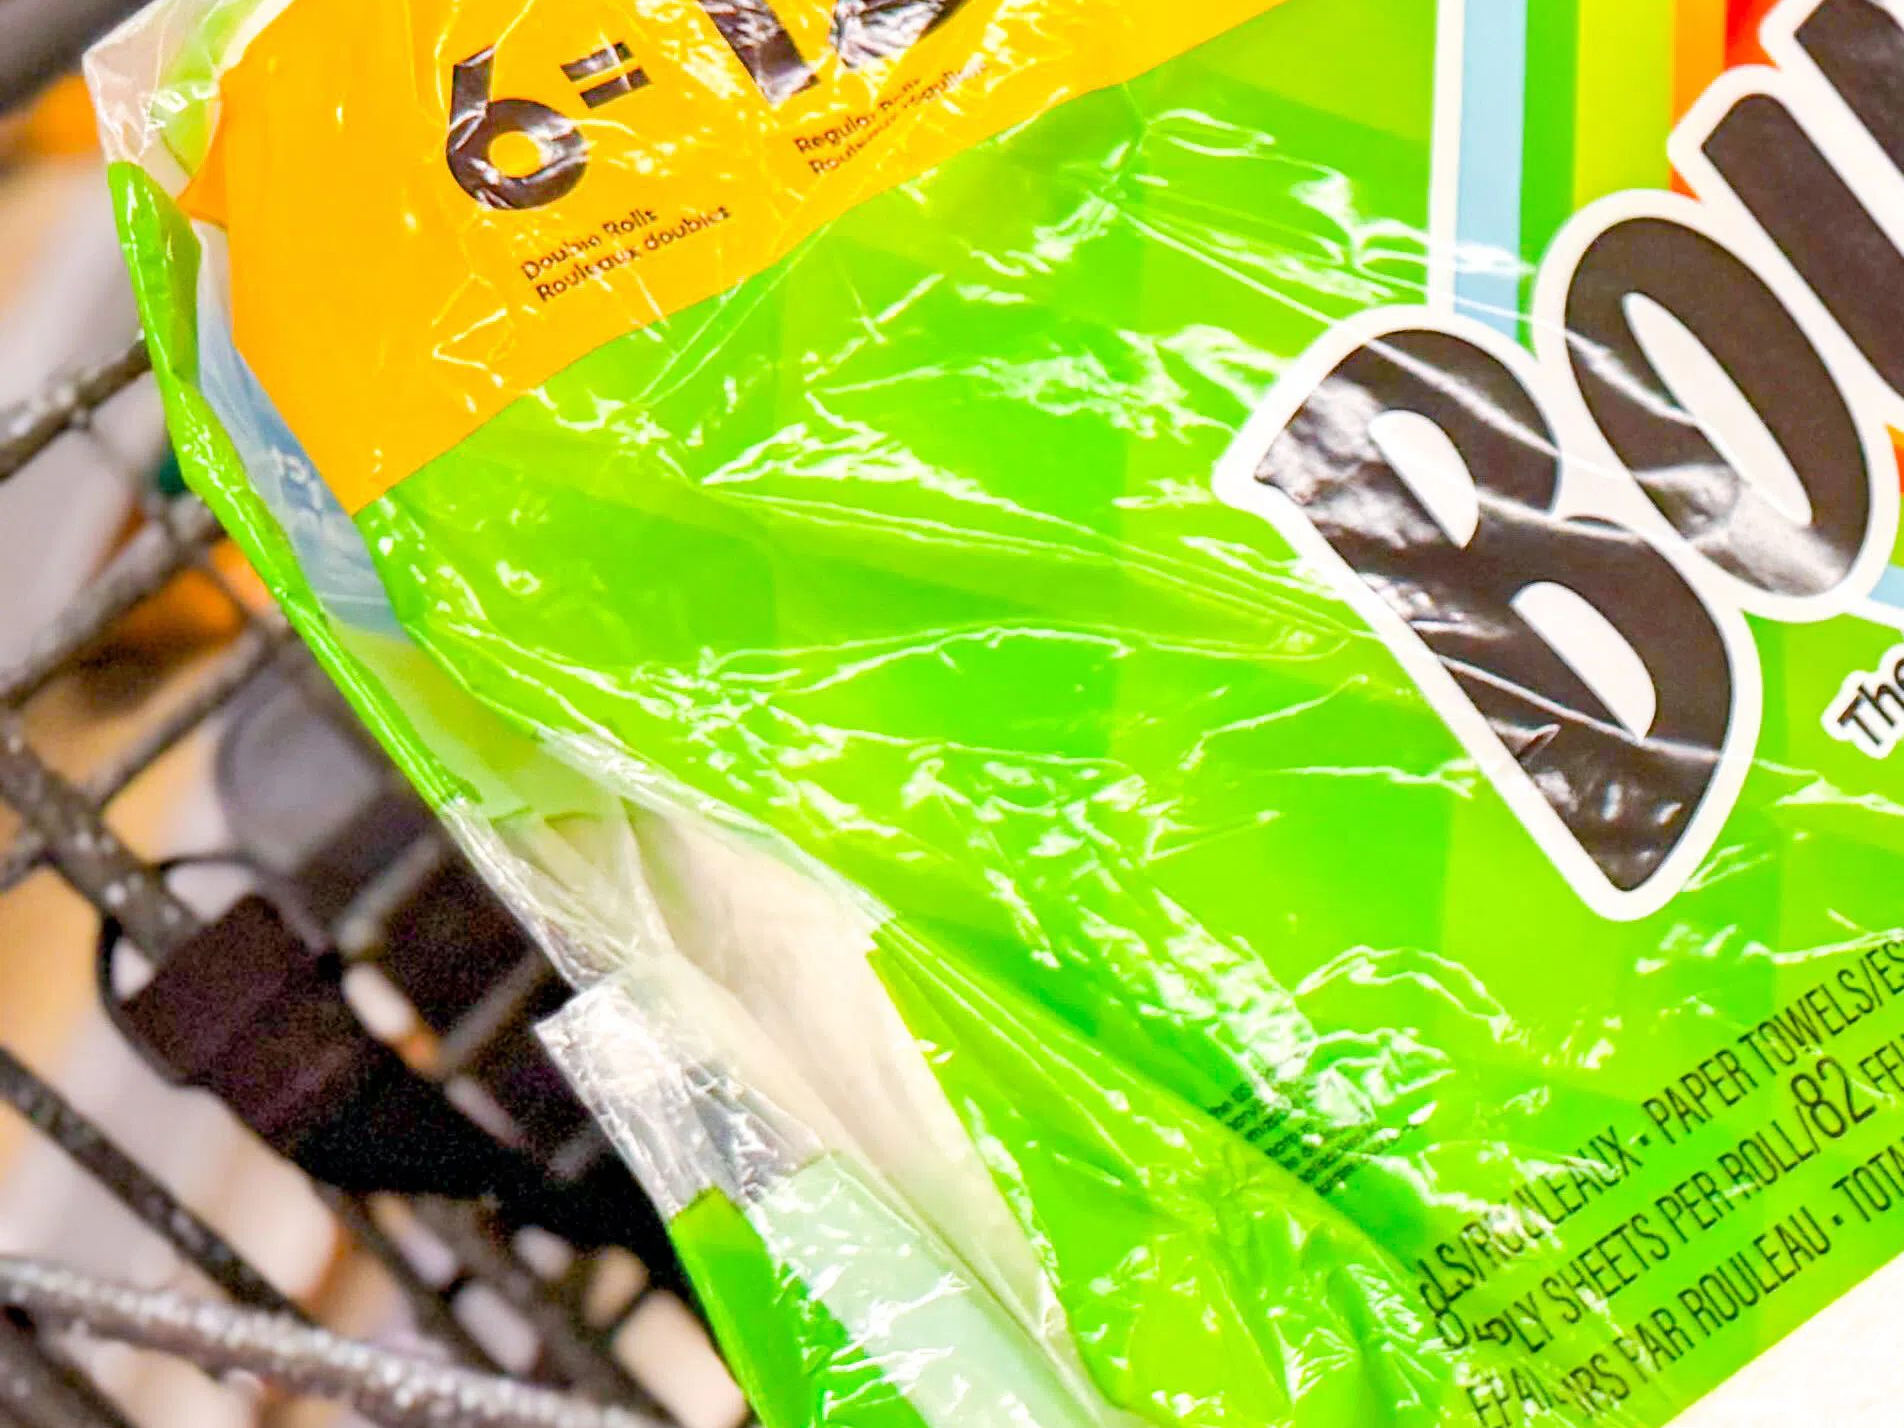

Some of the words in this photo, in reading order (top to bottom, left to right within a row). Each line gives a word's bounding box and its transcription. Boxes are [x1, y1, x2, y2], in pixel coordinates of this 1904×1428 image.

[1643, 1048, 1755, 1146] PAPER
[1540, 1211, 1673, 1325] SHEETS
[1655, 1168, 1736, 1250] PER
[1680, 1204, 1832, 1327] ROULEAU
